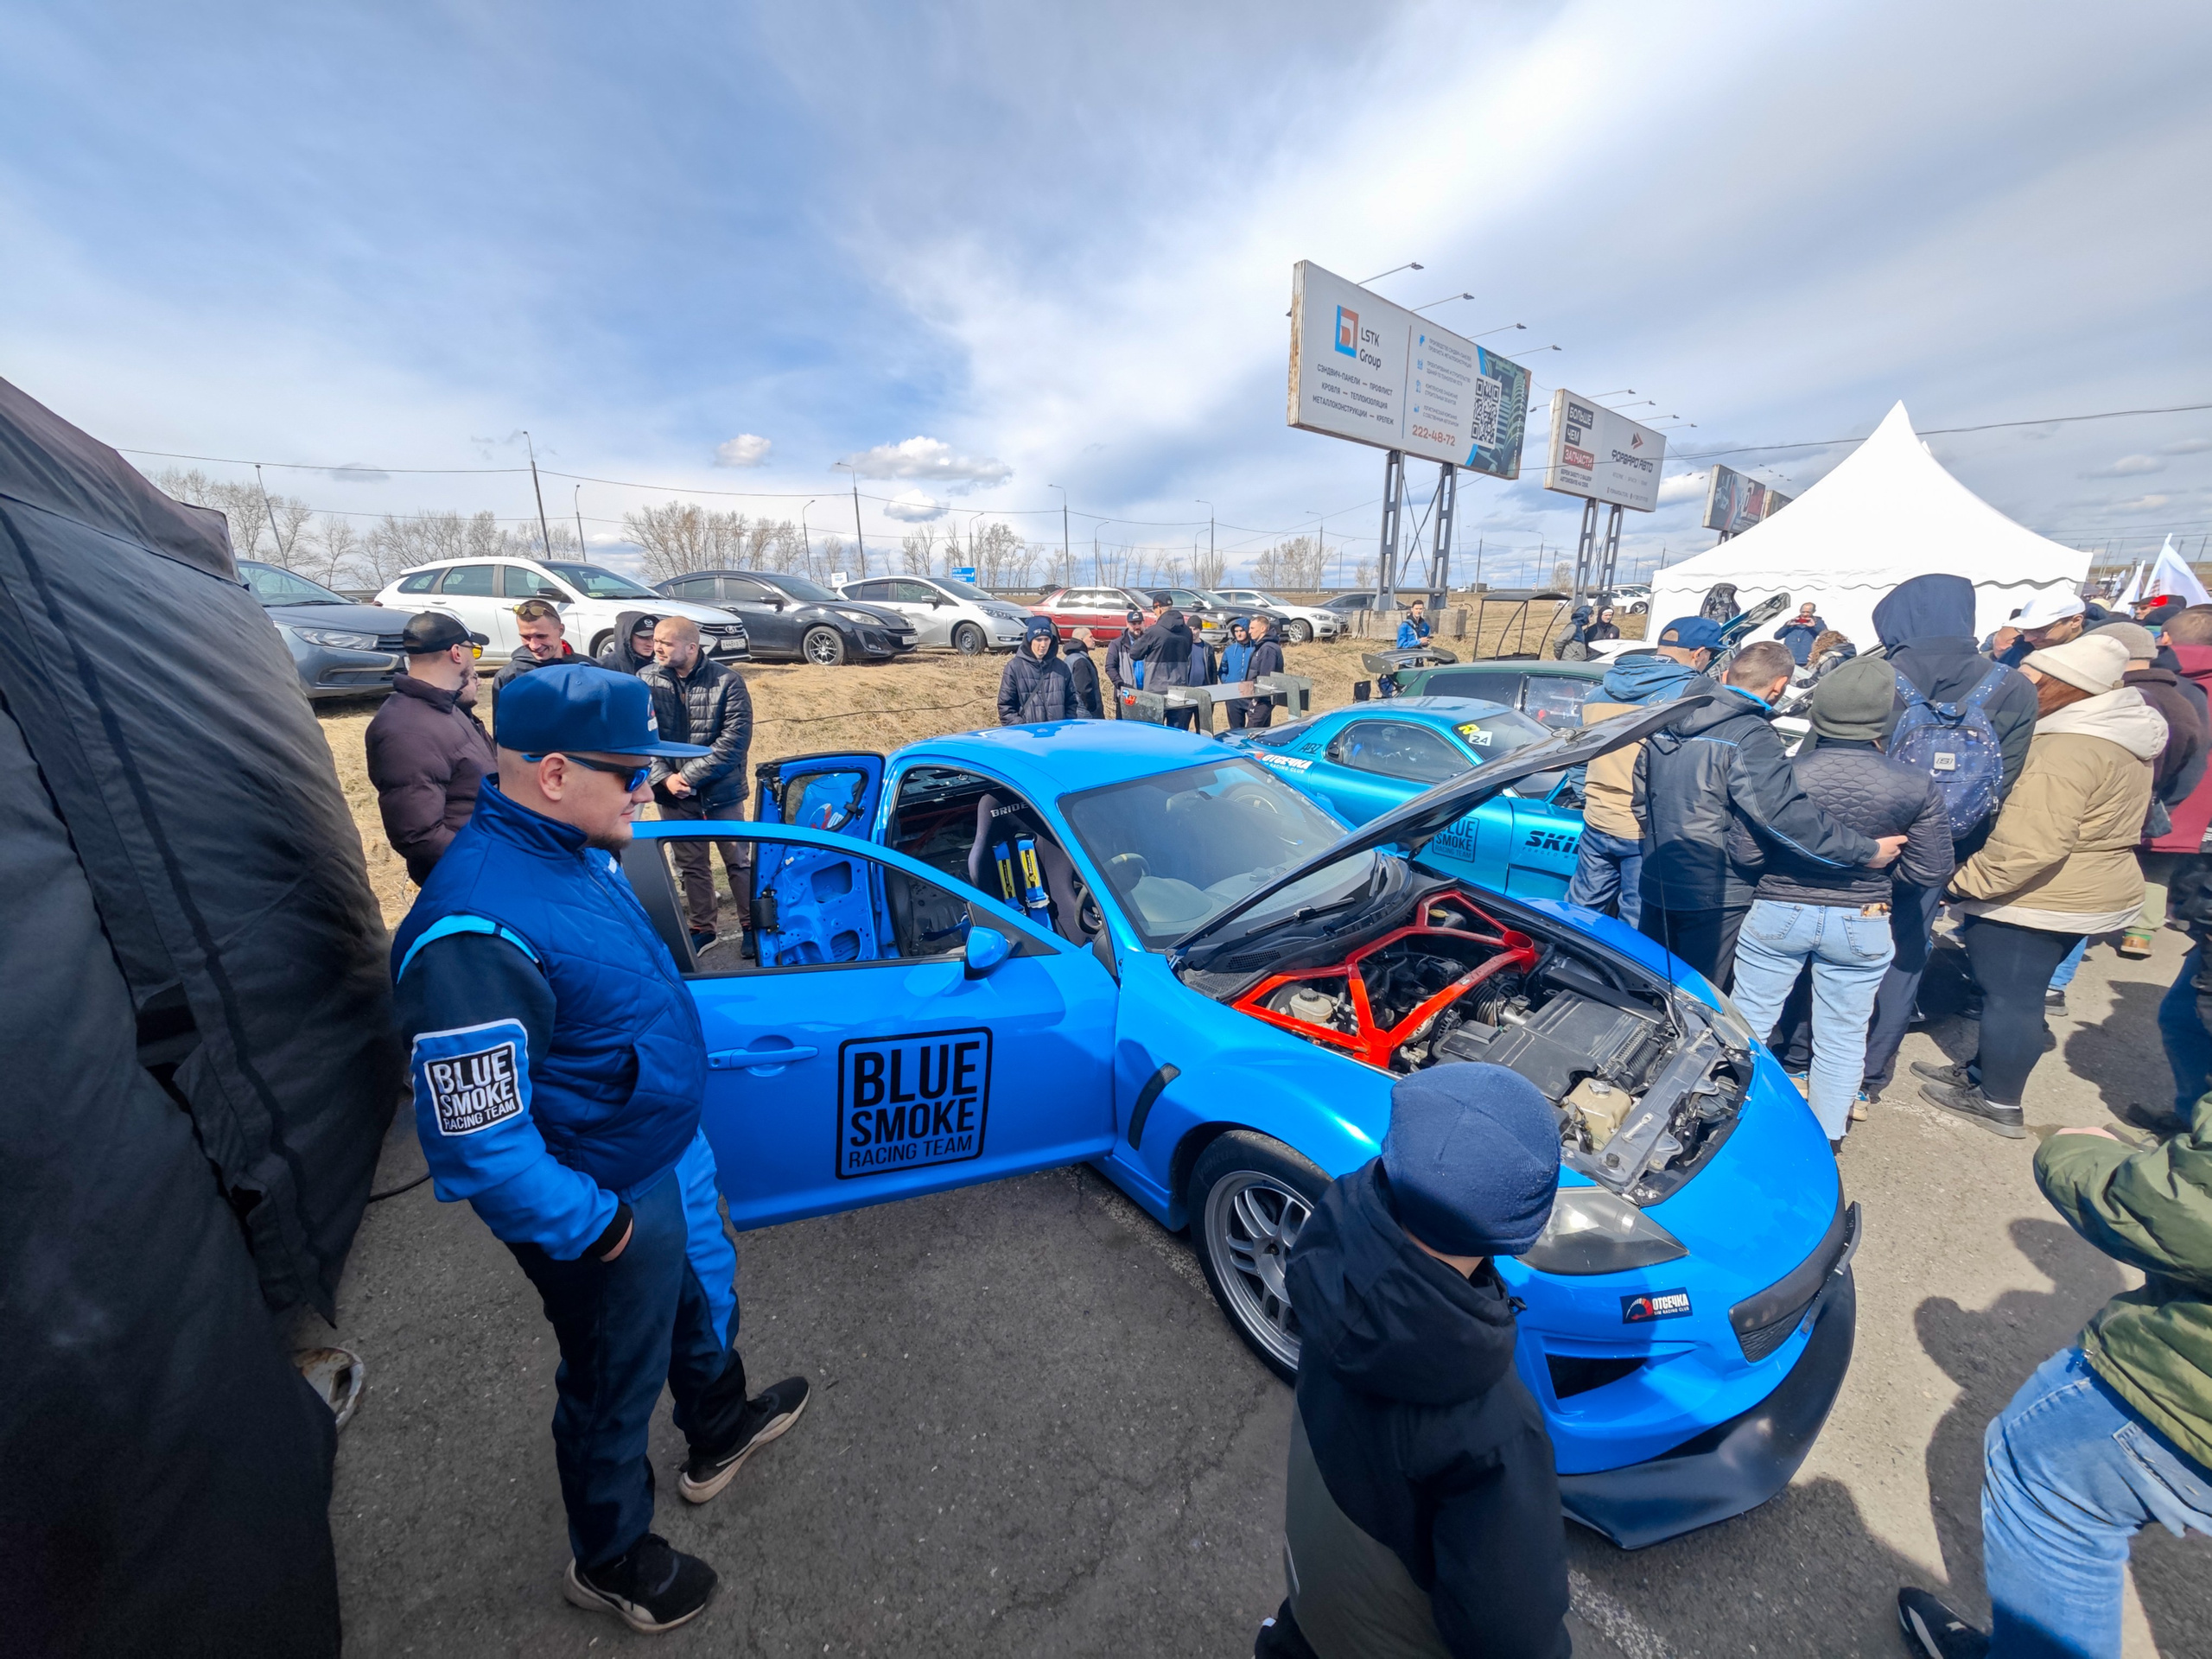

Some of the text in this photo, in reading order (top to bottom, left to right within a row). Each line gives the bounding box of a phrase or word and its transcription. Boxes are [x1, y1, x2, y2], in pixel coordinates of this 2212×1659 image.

[1361, 327, 1380, 346] LSTK
[1359, 348, 1381, 371] Group
[1321, 382, 1388, 410] КРОВЛЯ ТЕПЛОИЗОЛЯЦИЯ
[1370, 383, 1393, 397] ПРОФЛИСТ
[1568, 406, 1592, 425] БОЛЬШЕ
[1412, 424, 1455, 447] 222-48-72
[1567, 428, 1580, 442] ЧЕМ
[1565, 449, 1593, 468] ЗАПЧАСТИ
[1471, 735, 1488, 744] 24
[1262, 754, 1313, 770] ОТСЕЧКА
[990, 802, 1028, 817] BRIDE
[1445, 820, 1475, 839] LUE
[1436, 832, 1472, 851] SMOKE
[1435, 845, 1471, 858] RACING TEAM
[432, 1049, 512, 1094] BLUE
[854, 1041, 980, 1108] BLUE
[440, 1077, 513, 1117] SMOKE
[443, 1099, 516, 1130] RACING TEAM
[850, 1096, 976, 1147] SMOKE
[849, 1135, 972, 1168] RACING TEAM
[1652, 1294, 1689, 1310] ОТСЕЧКА
